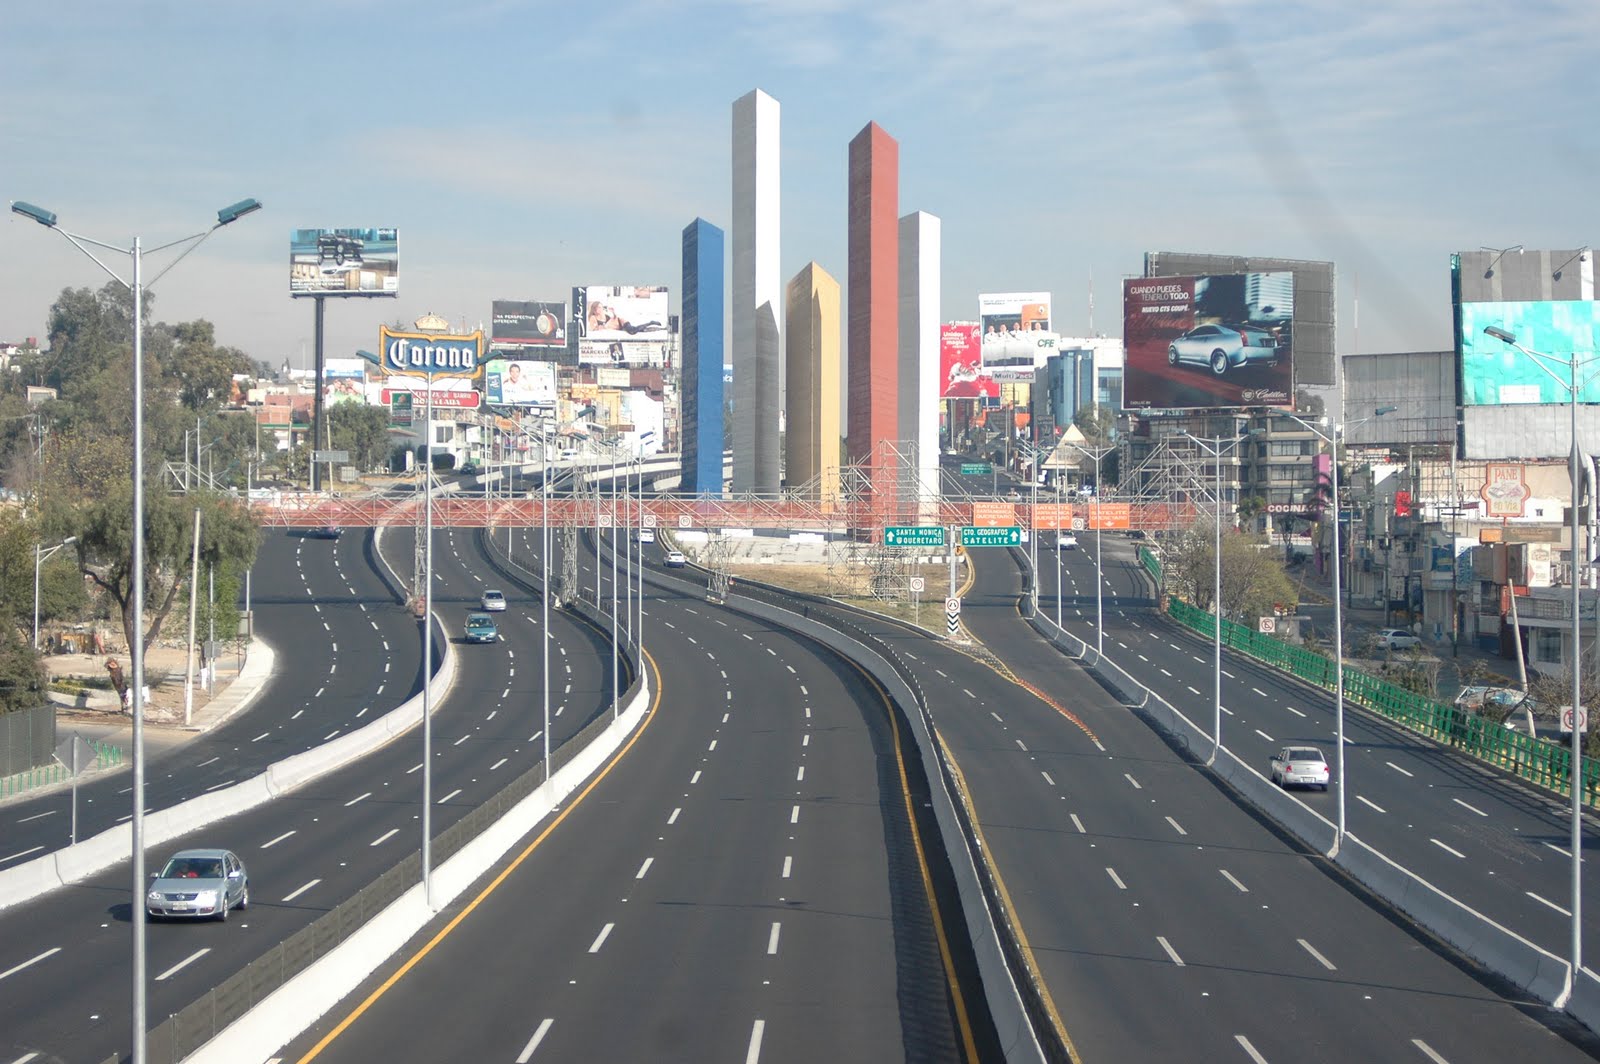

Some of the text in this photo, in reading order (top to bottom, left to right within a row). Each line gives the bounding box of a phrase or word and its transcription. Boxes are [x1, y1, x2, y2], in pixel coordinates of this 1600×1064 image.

[1131, 285, 1181, 294] CUANDO PUEDES
[1037, 338, 1054, 348] CFE
[390, 338, 475, 370] Corona
[1256, 388, 1287, 399] Cadillac
[1494, 468, 1518, 482] PANE
